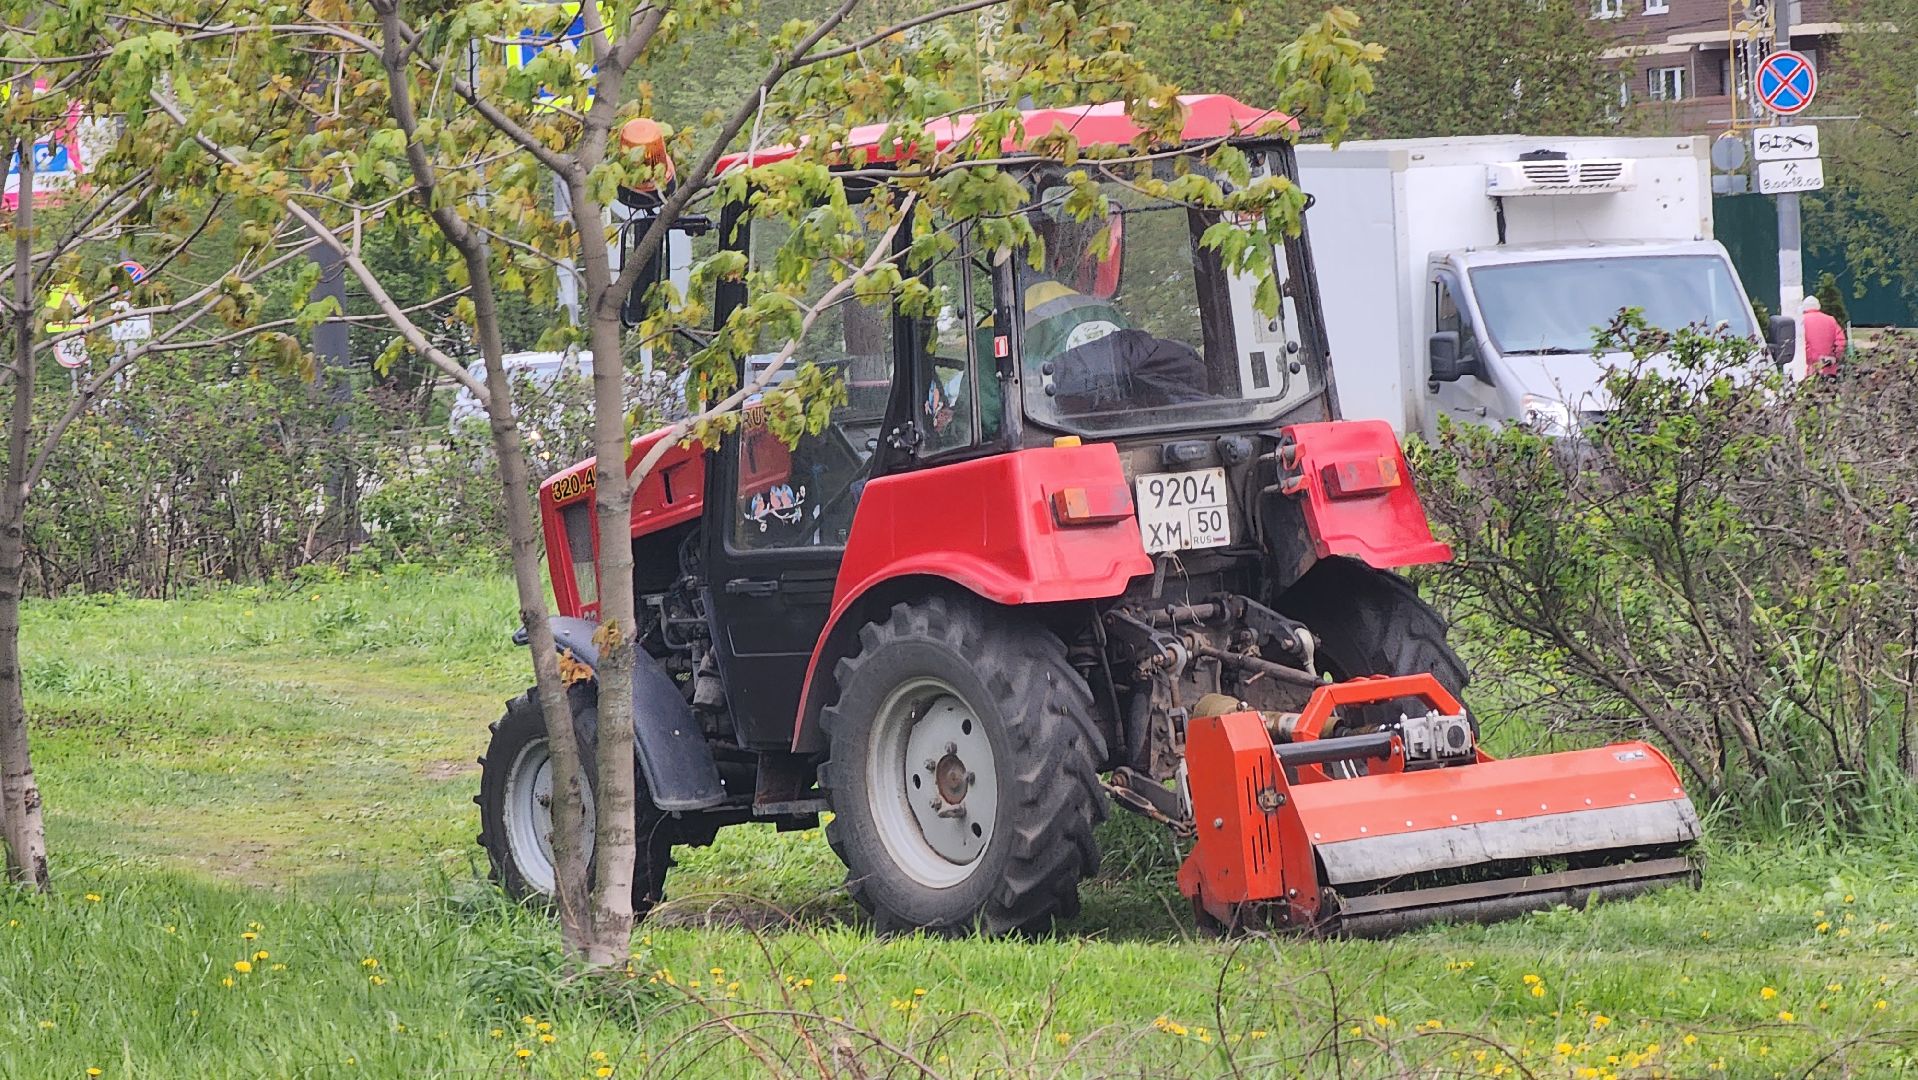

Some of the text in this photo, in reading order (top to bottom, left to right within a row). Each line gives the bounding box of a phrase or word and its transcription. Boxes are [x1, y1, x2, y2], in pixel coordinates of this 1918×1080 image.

[552, 466, 597, 502] 320.4
[1149, 473, 1216, 509] 9204
[1197, 510, 1222, 533] 50
[1193, 535, 1212, 545] RUS
